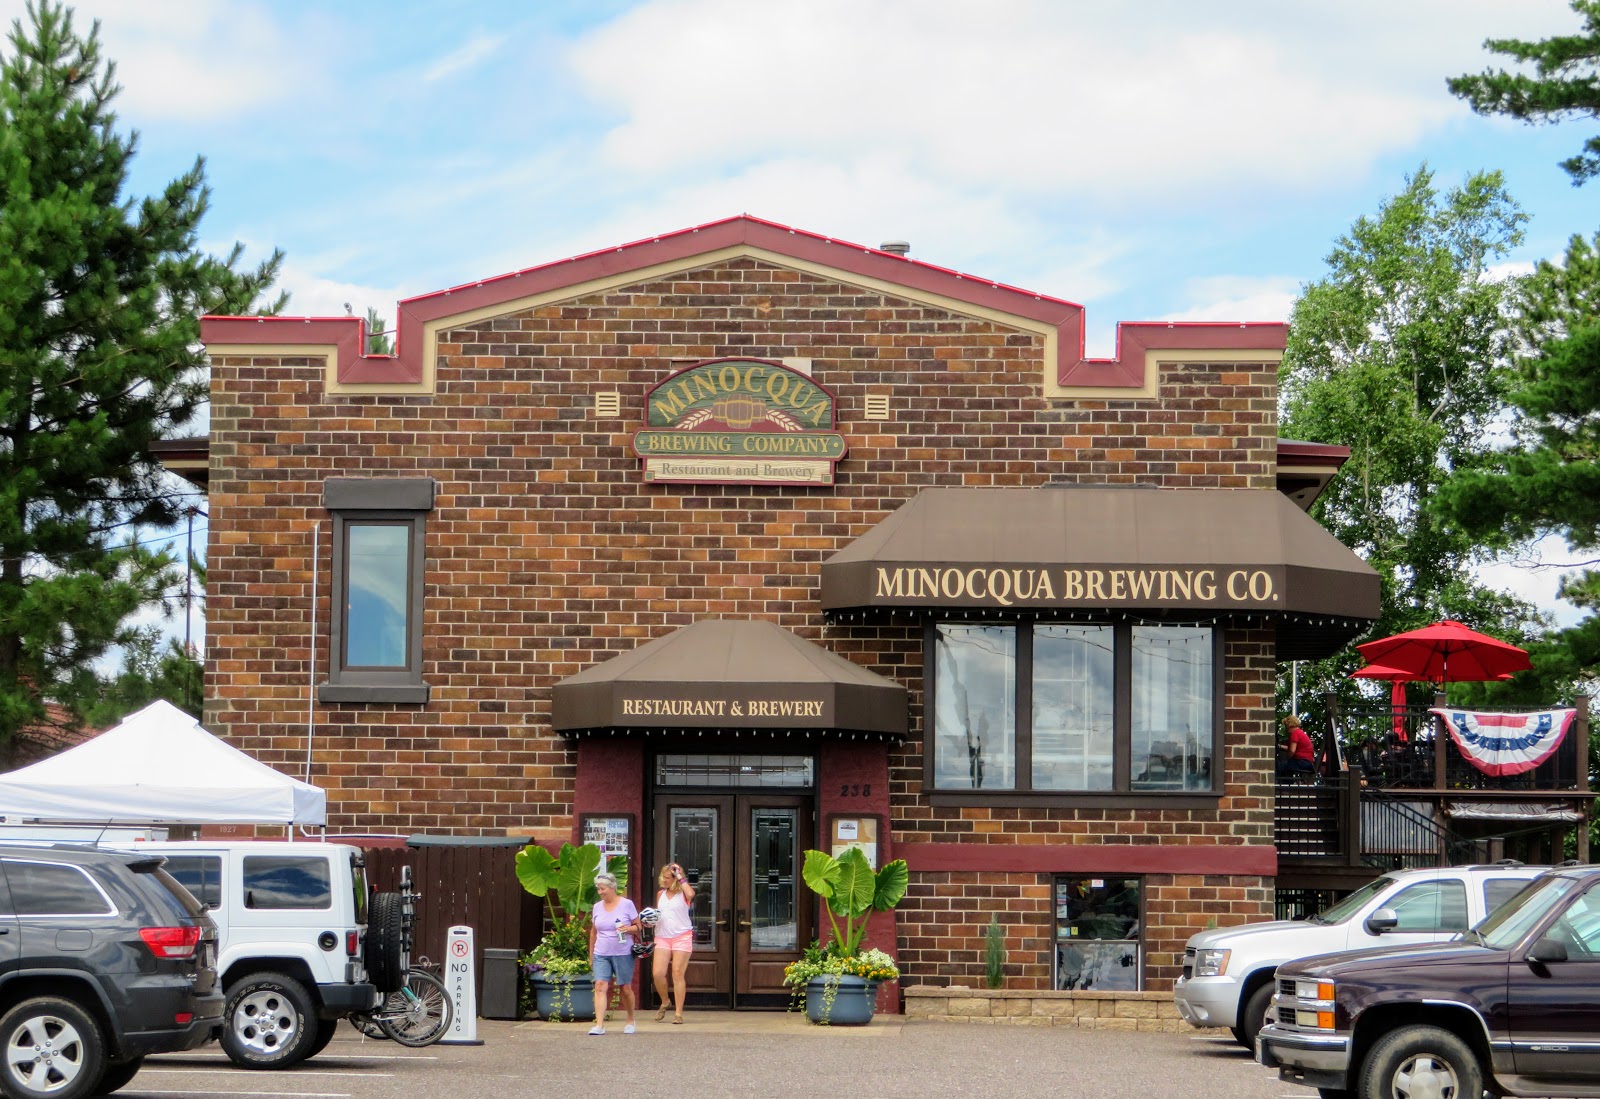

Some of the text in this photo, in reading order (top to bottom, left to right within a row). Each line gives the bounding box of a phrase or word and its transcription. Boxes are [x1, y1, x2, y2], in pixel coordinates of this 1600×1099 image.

[655, 366, 829, 427] MINOCQUA
[648, 435, 831, 454] BREWING COMPANY
[661, 462, 816, 481] Restaurant and Brewery
[875, 567, 1279, 606] MINOCQUA BREWING CO.
[622, 699, 825, 717] RESTAURANT & BREWERY
[840, 783, 871, 798] 238
[451, 963, 468, 973] NO
[455, 976, 463, 1032] PARKING
